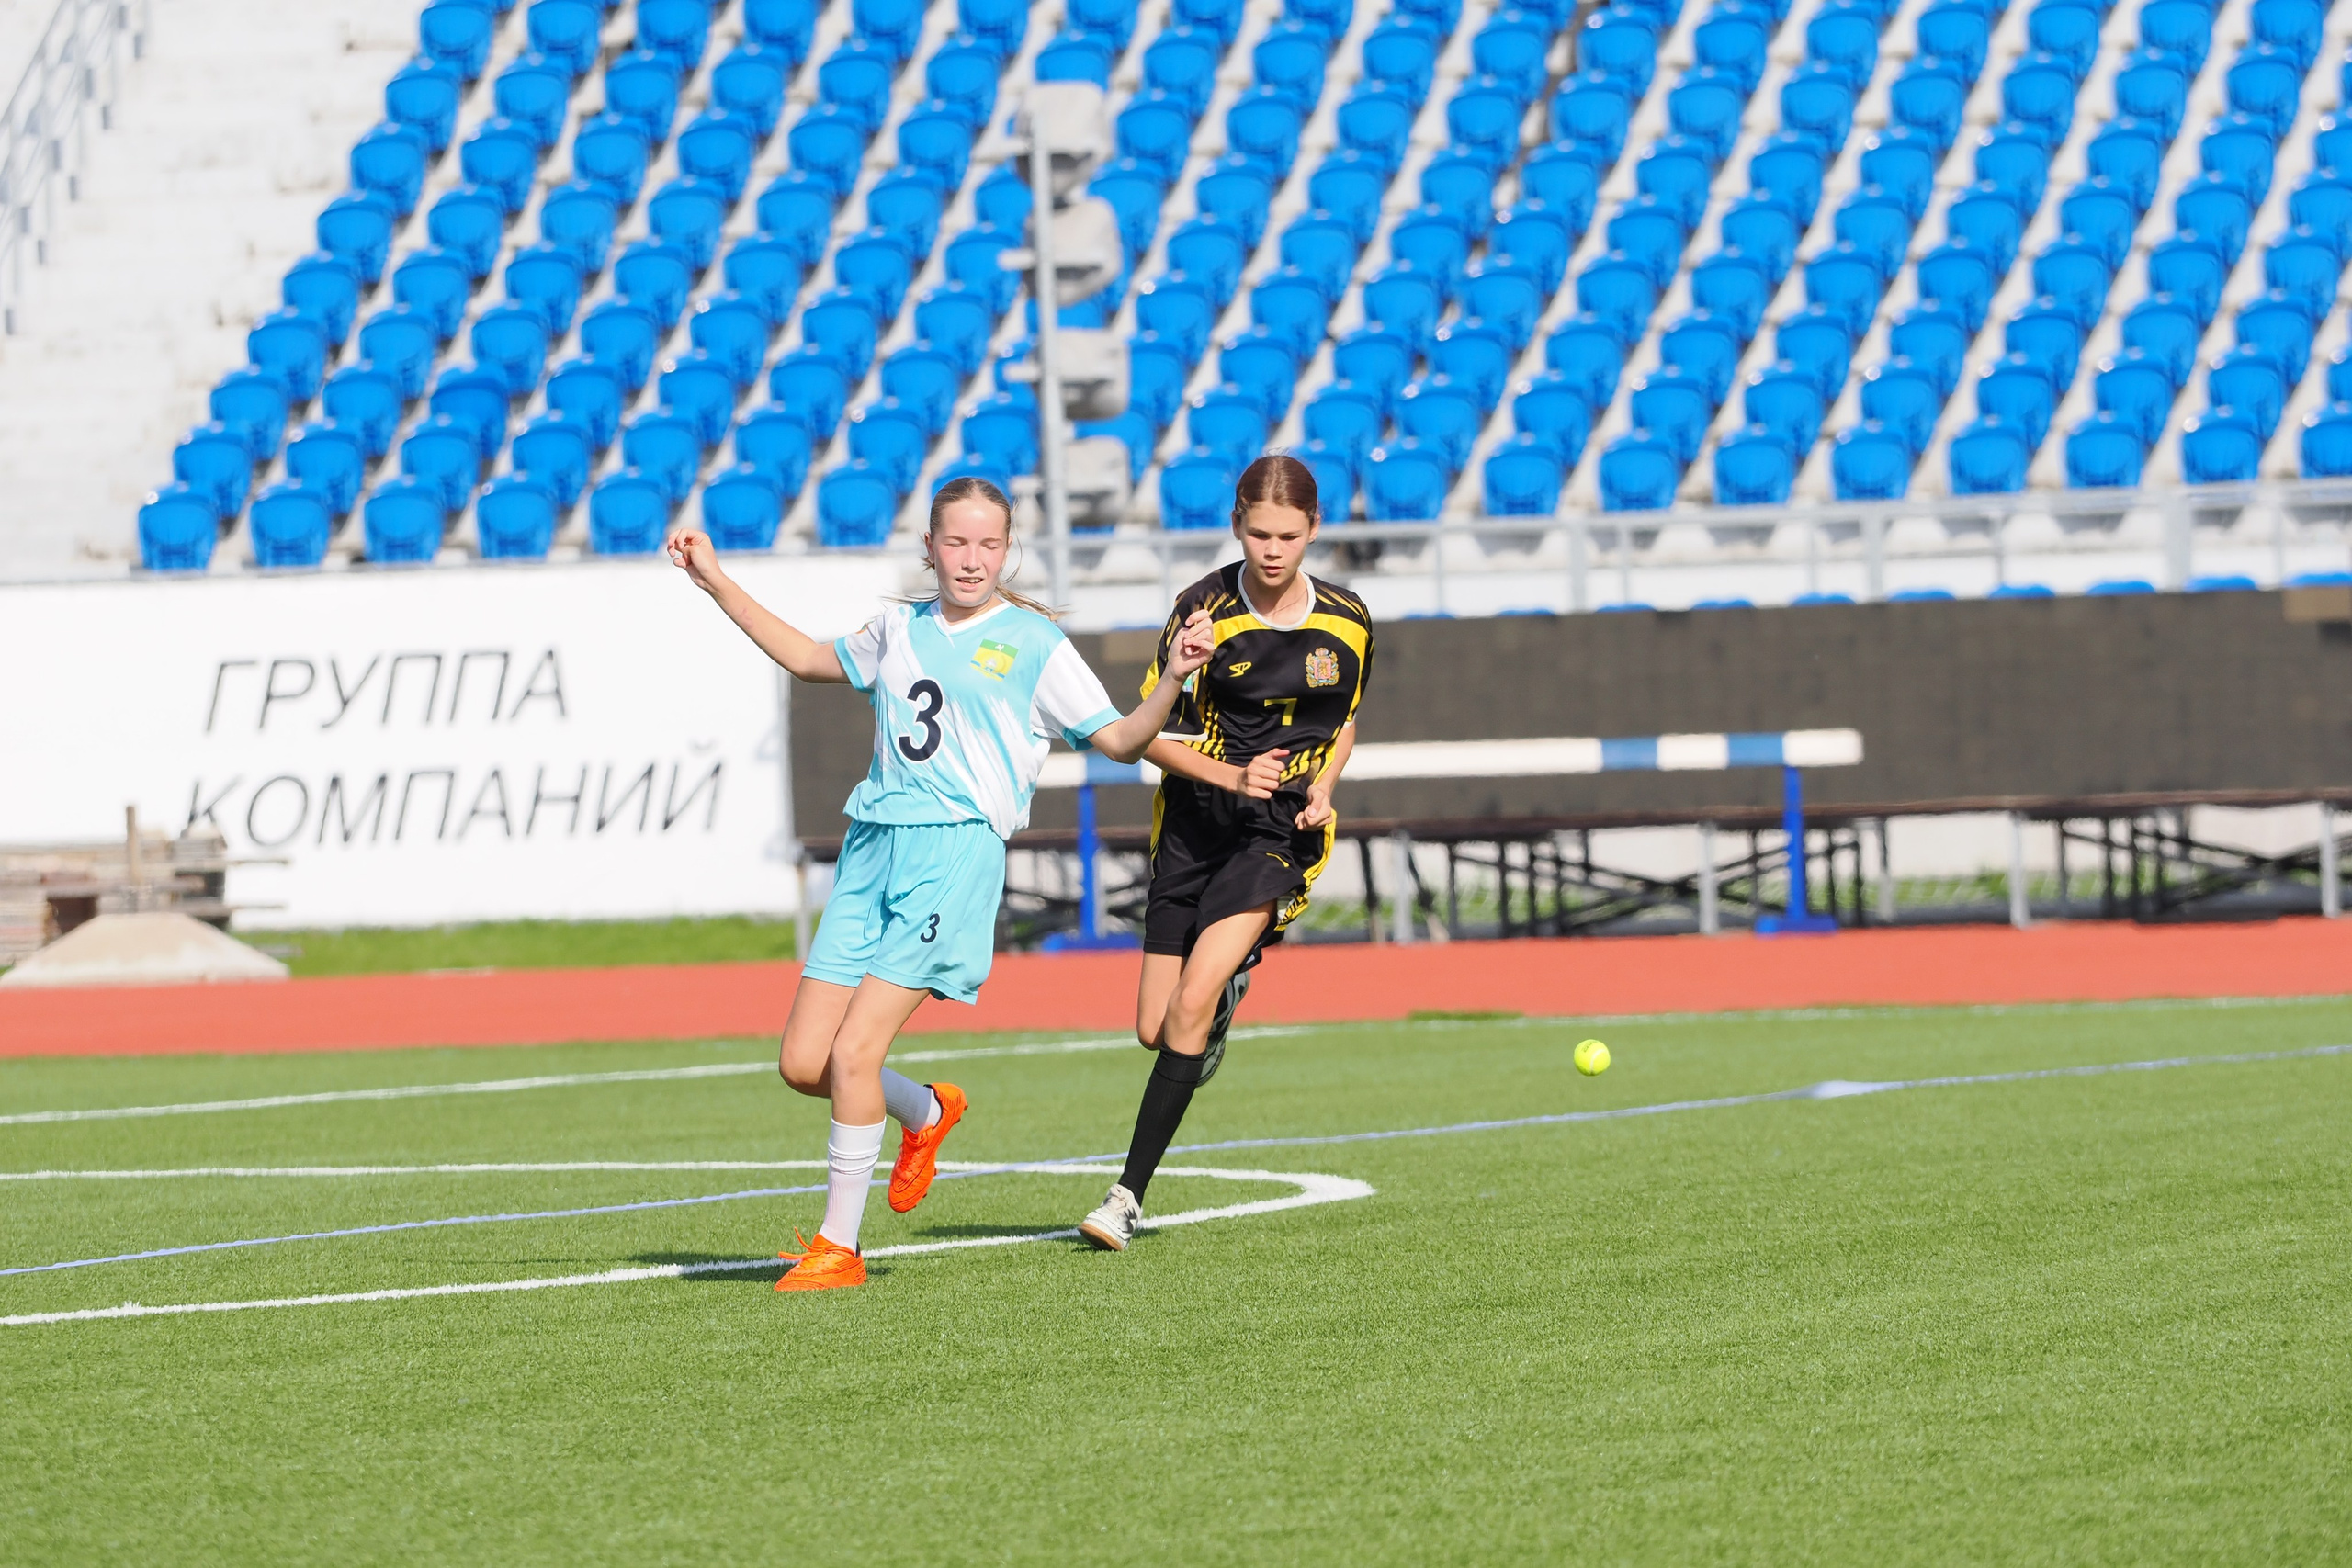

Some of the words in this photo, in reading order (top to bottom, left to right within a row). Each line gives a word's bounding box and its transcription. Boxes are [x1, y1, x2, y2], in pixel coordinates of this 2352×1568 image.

[206, 648, 567, 732] ГРУППА
[899, 680, 942, 761] 3
[1263, 697, 1297, 726] 7
[180, 739, 723, 848] КОМПАНИЙ
[920, 914, 939, 943] 3
